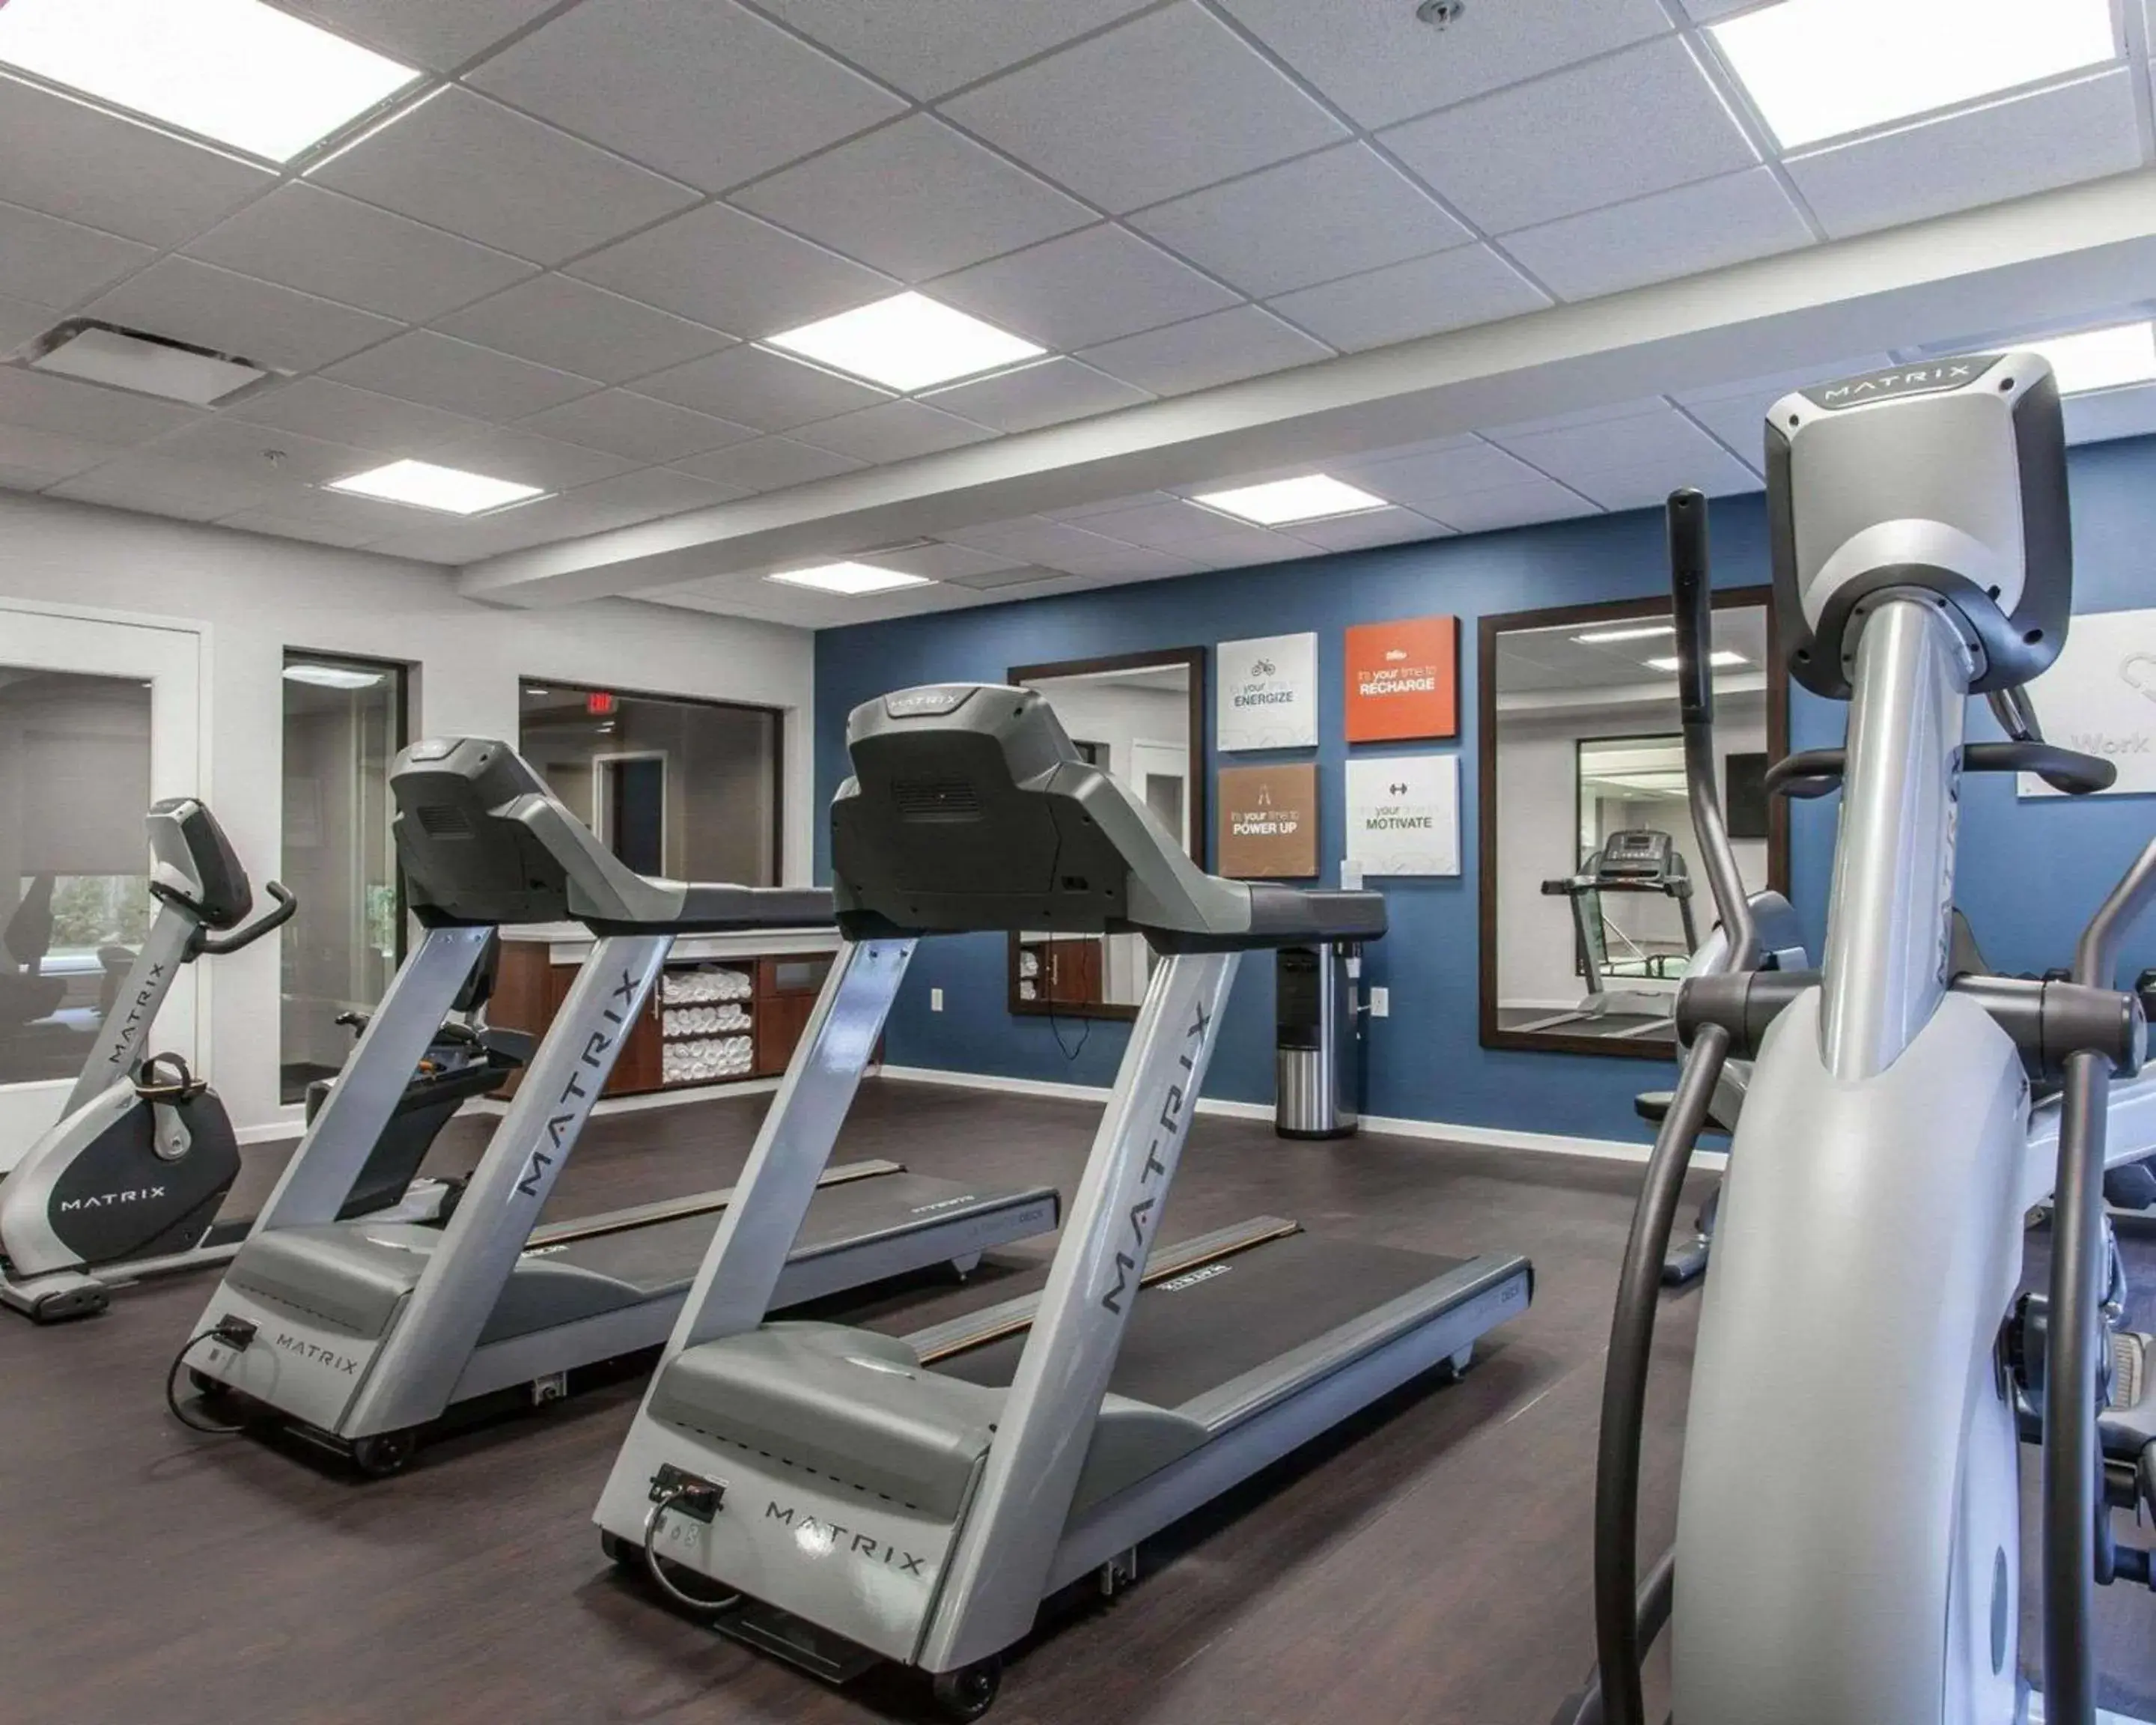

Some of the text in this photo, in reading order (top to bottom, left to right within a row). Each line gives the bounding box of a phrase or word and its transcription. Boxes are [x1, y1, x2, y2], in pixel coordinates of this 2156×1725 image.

[1824, 365, 1970, 401] MATRIX
[1359, 677, 1435, 696] RECHARGE
[1373, 669, 1398, 683] your
[1234, 690, 1294, 707] ENERGIZE
[2069, 732, 2151, 755] Work
[1233, 821, 1297, 836] POWER UP
[1243, 812, 1267, 824] your
[1365, 816, 1433, 830] MOTIVATE
[109, 962, 164, 1063] MATRIX
[517, 968, 642, 1196] MATRIX
[1101, 1000, 1211, 1315] MATRIX
[61, 1186, 165, 1212] MATRIX
[275, 1333, 358, 1375] MATRIX
[764, 1501, 927, 1576] MATRIX
